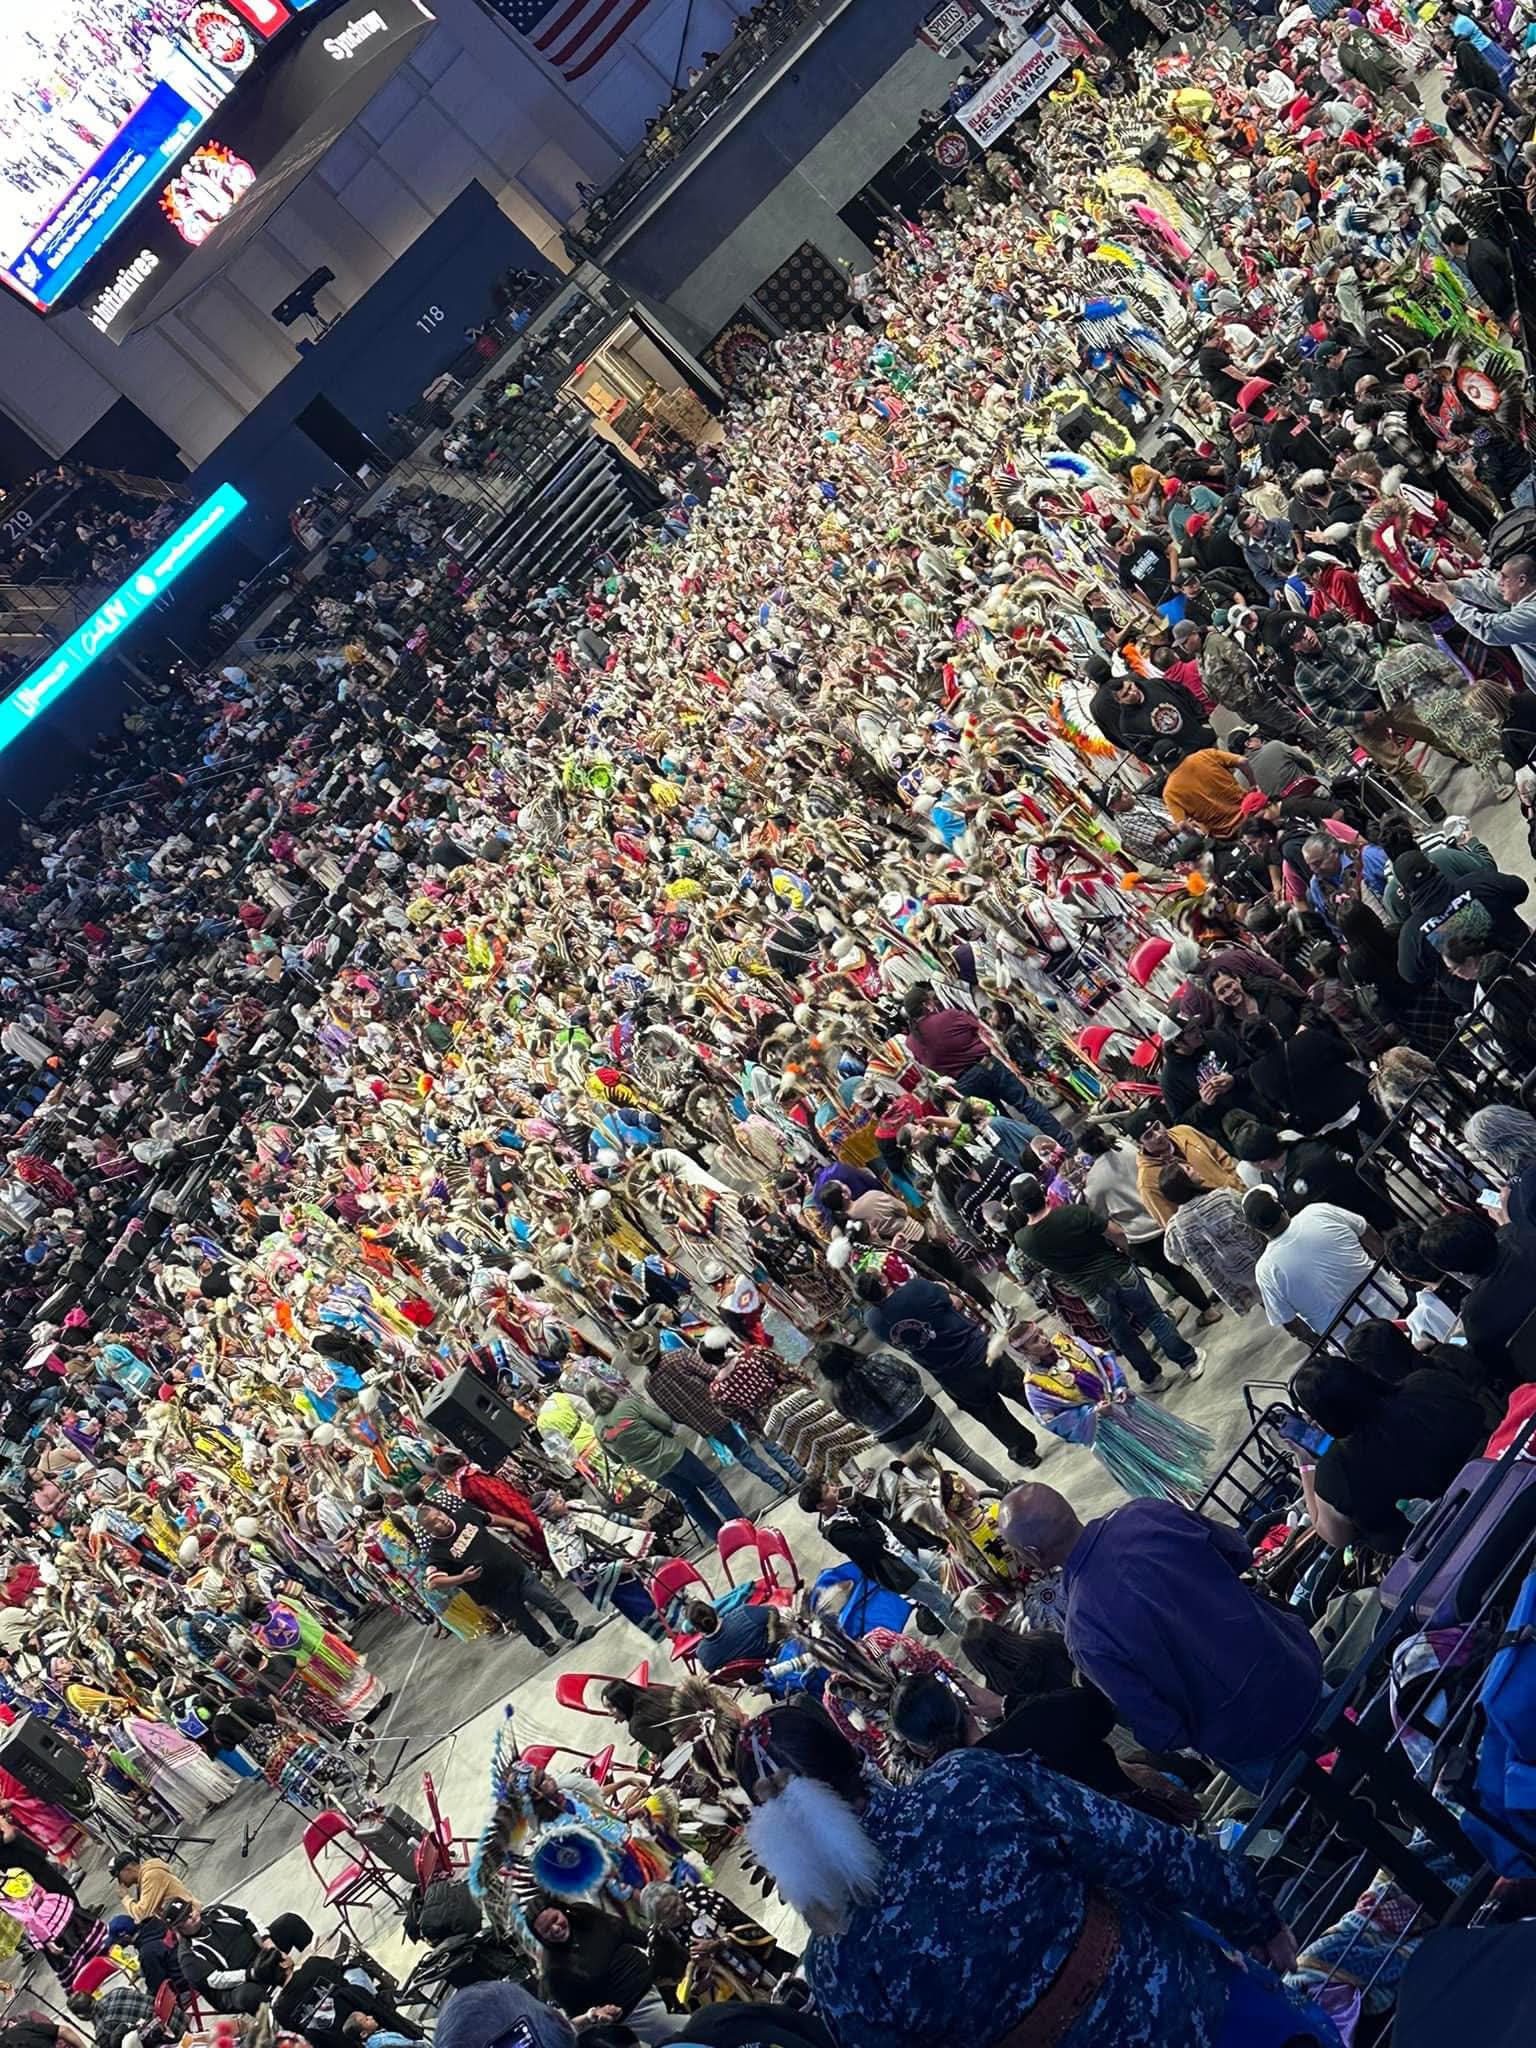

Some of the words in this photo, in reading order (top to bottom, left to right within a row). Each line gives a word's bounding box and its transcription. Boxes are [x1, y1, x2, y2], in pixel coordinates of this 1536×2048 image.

[928, 5, 961, 38] SPORTS
[967, 103, 994, 129] BLACK
[990, 82, 1014, 106] HILLS
[1010, 50, 1045, 86] POWWOW
[973, 117, 993, 137] HE
[990, 90, 1021, 120] SAPA
[1018, 50, 1060, 92] WACIPI
[92, 249, 159, 324] Initiatives
[416, 305, 445, 334] 118
[2, 510, 33, 541] 219
